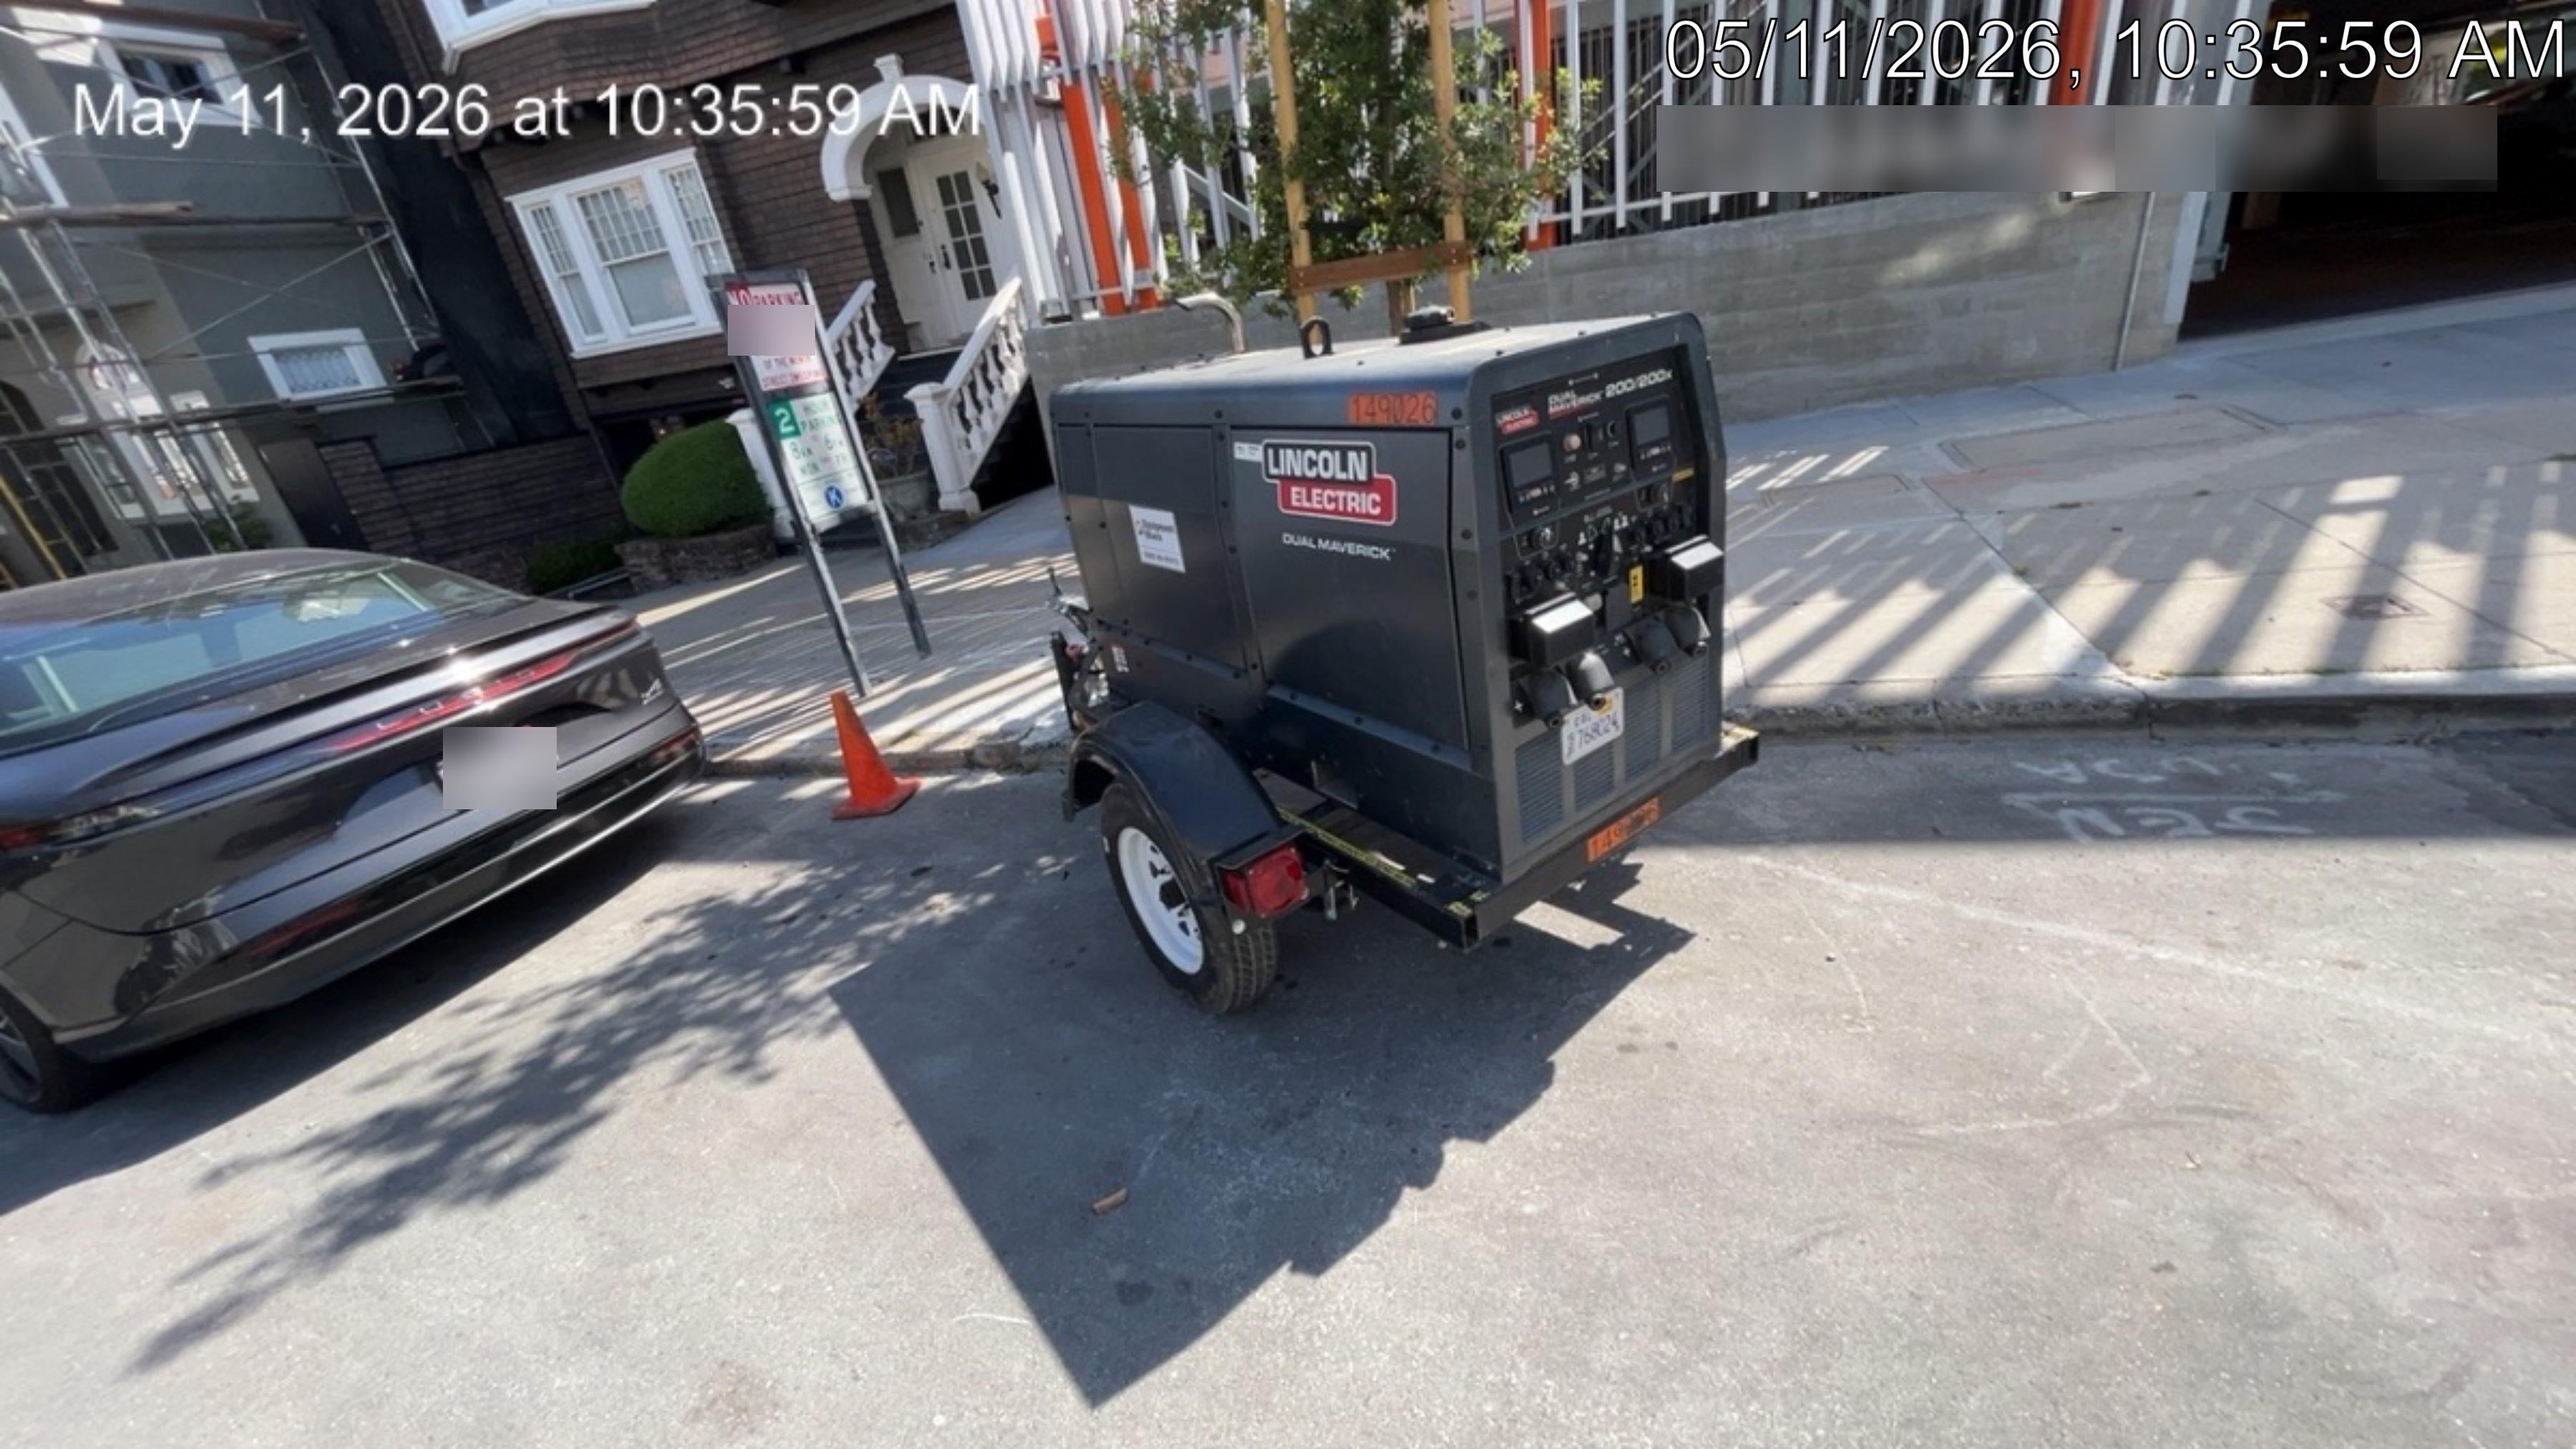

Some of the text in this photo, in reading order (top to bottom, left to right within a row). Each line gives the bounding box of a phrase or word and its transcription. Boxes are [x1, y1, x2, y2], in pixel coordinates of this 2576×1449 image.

[774, 406, 794, 434] 2
[1352, 394, 1437, 424] 149026
[1267, 448, 1368, 482] LINCOLN
[1290, 486, 1381, 515] ELECTRIC
[1282, 532, 1391, 560] DUAL MAVERICK
